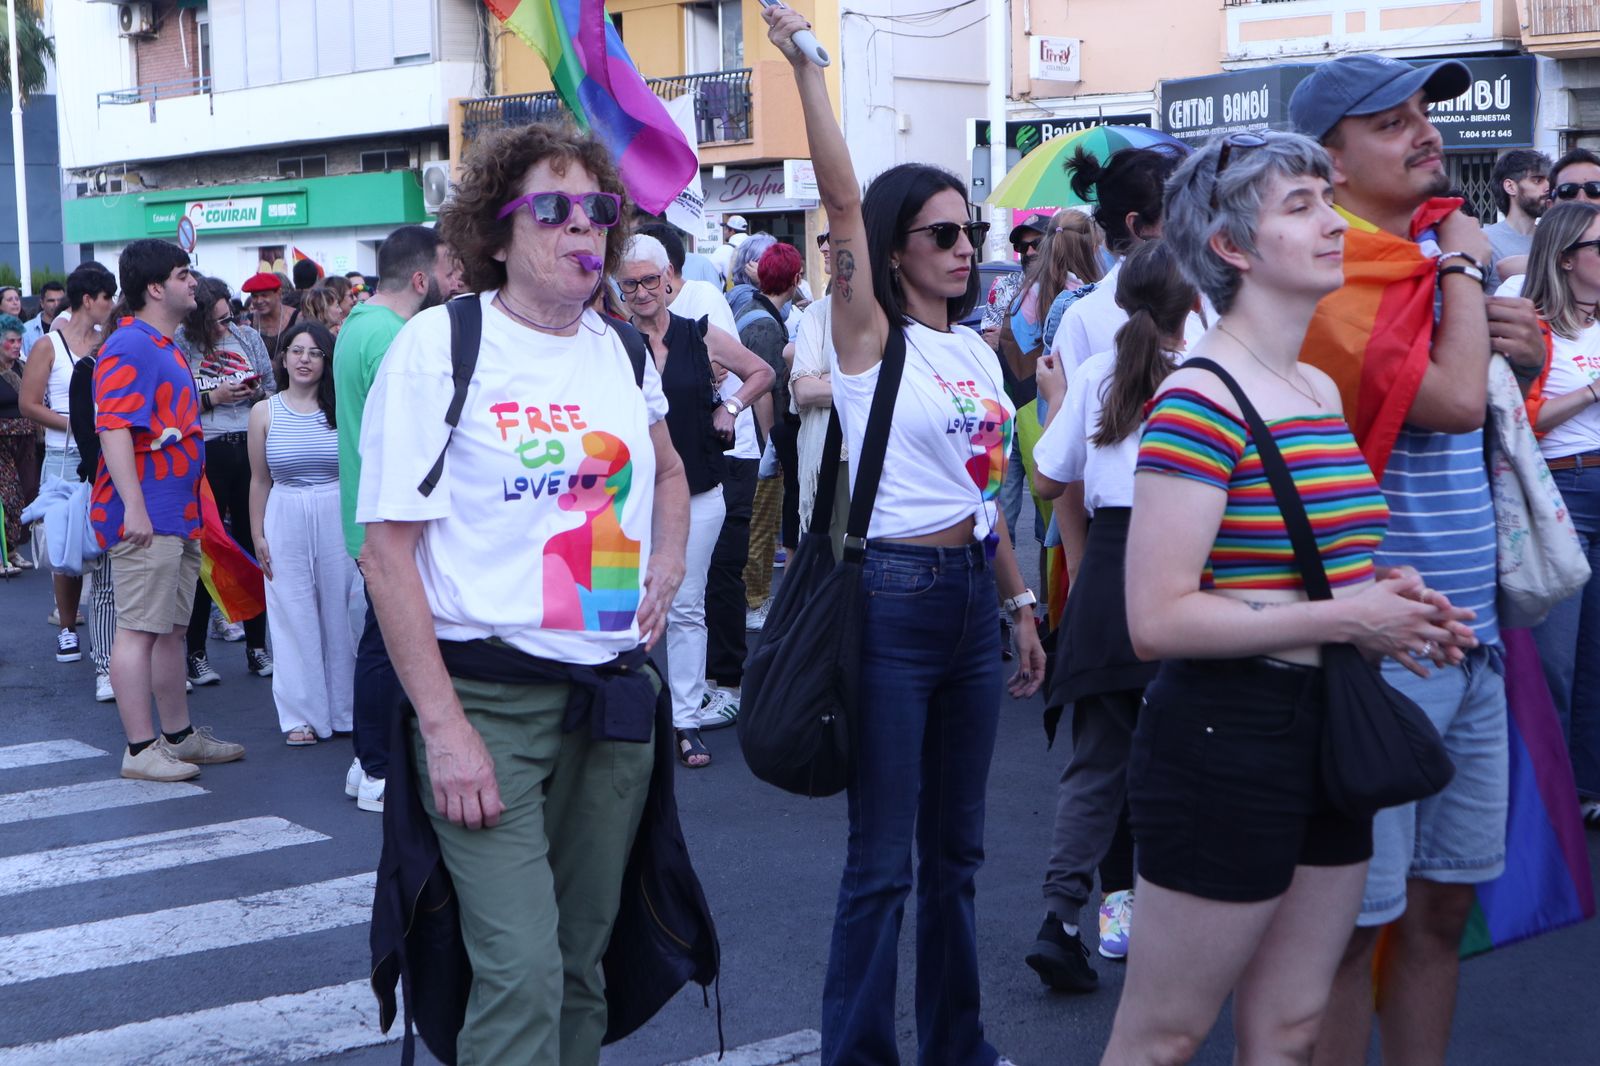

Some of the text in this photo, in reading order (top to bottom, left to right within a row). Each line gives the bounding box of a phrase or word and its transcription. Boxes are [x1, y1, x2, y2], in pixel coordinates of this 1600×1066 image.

[1169, 83, 1269, 129] CENTRO BAMBÚ
[1471, 114, 1511, 122] BIENESTAR
[1482, 130, 1496, 138] 912
[206, 207, 257, 223] COVIRAN
[489, 402, 587, 441] FREE
[946, 416, 977, 434] LOVE
[514, 434, 565, 469] to
[503, 470, 565, 502] LOVE
